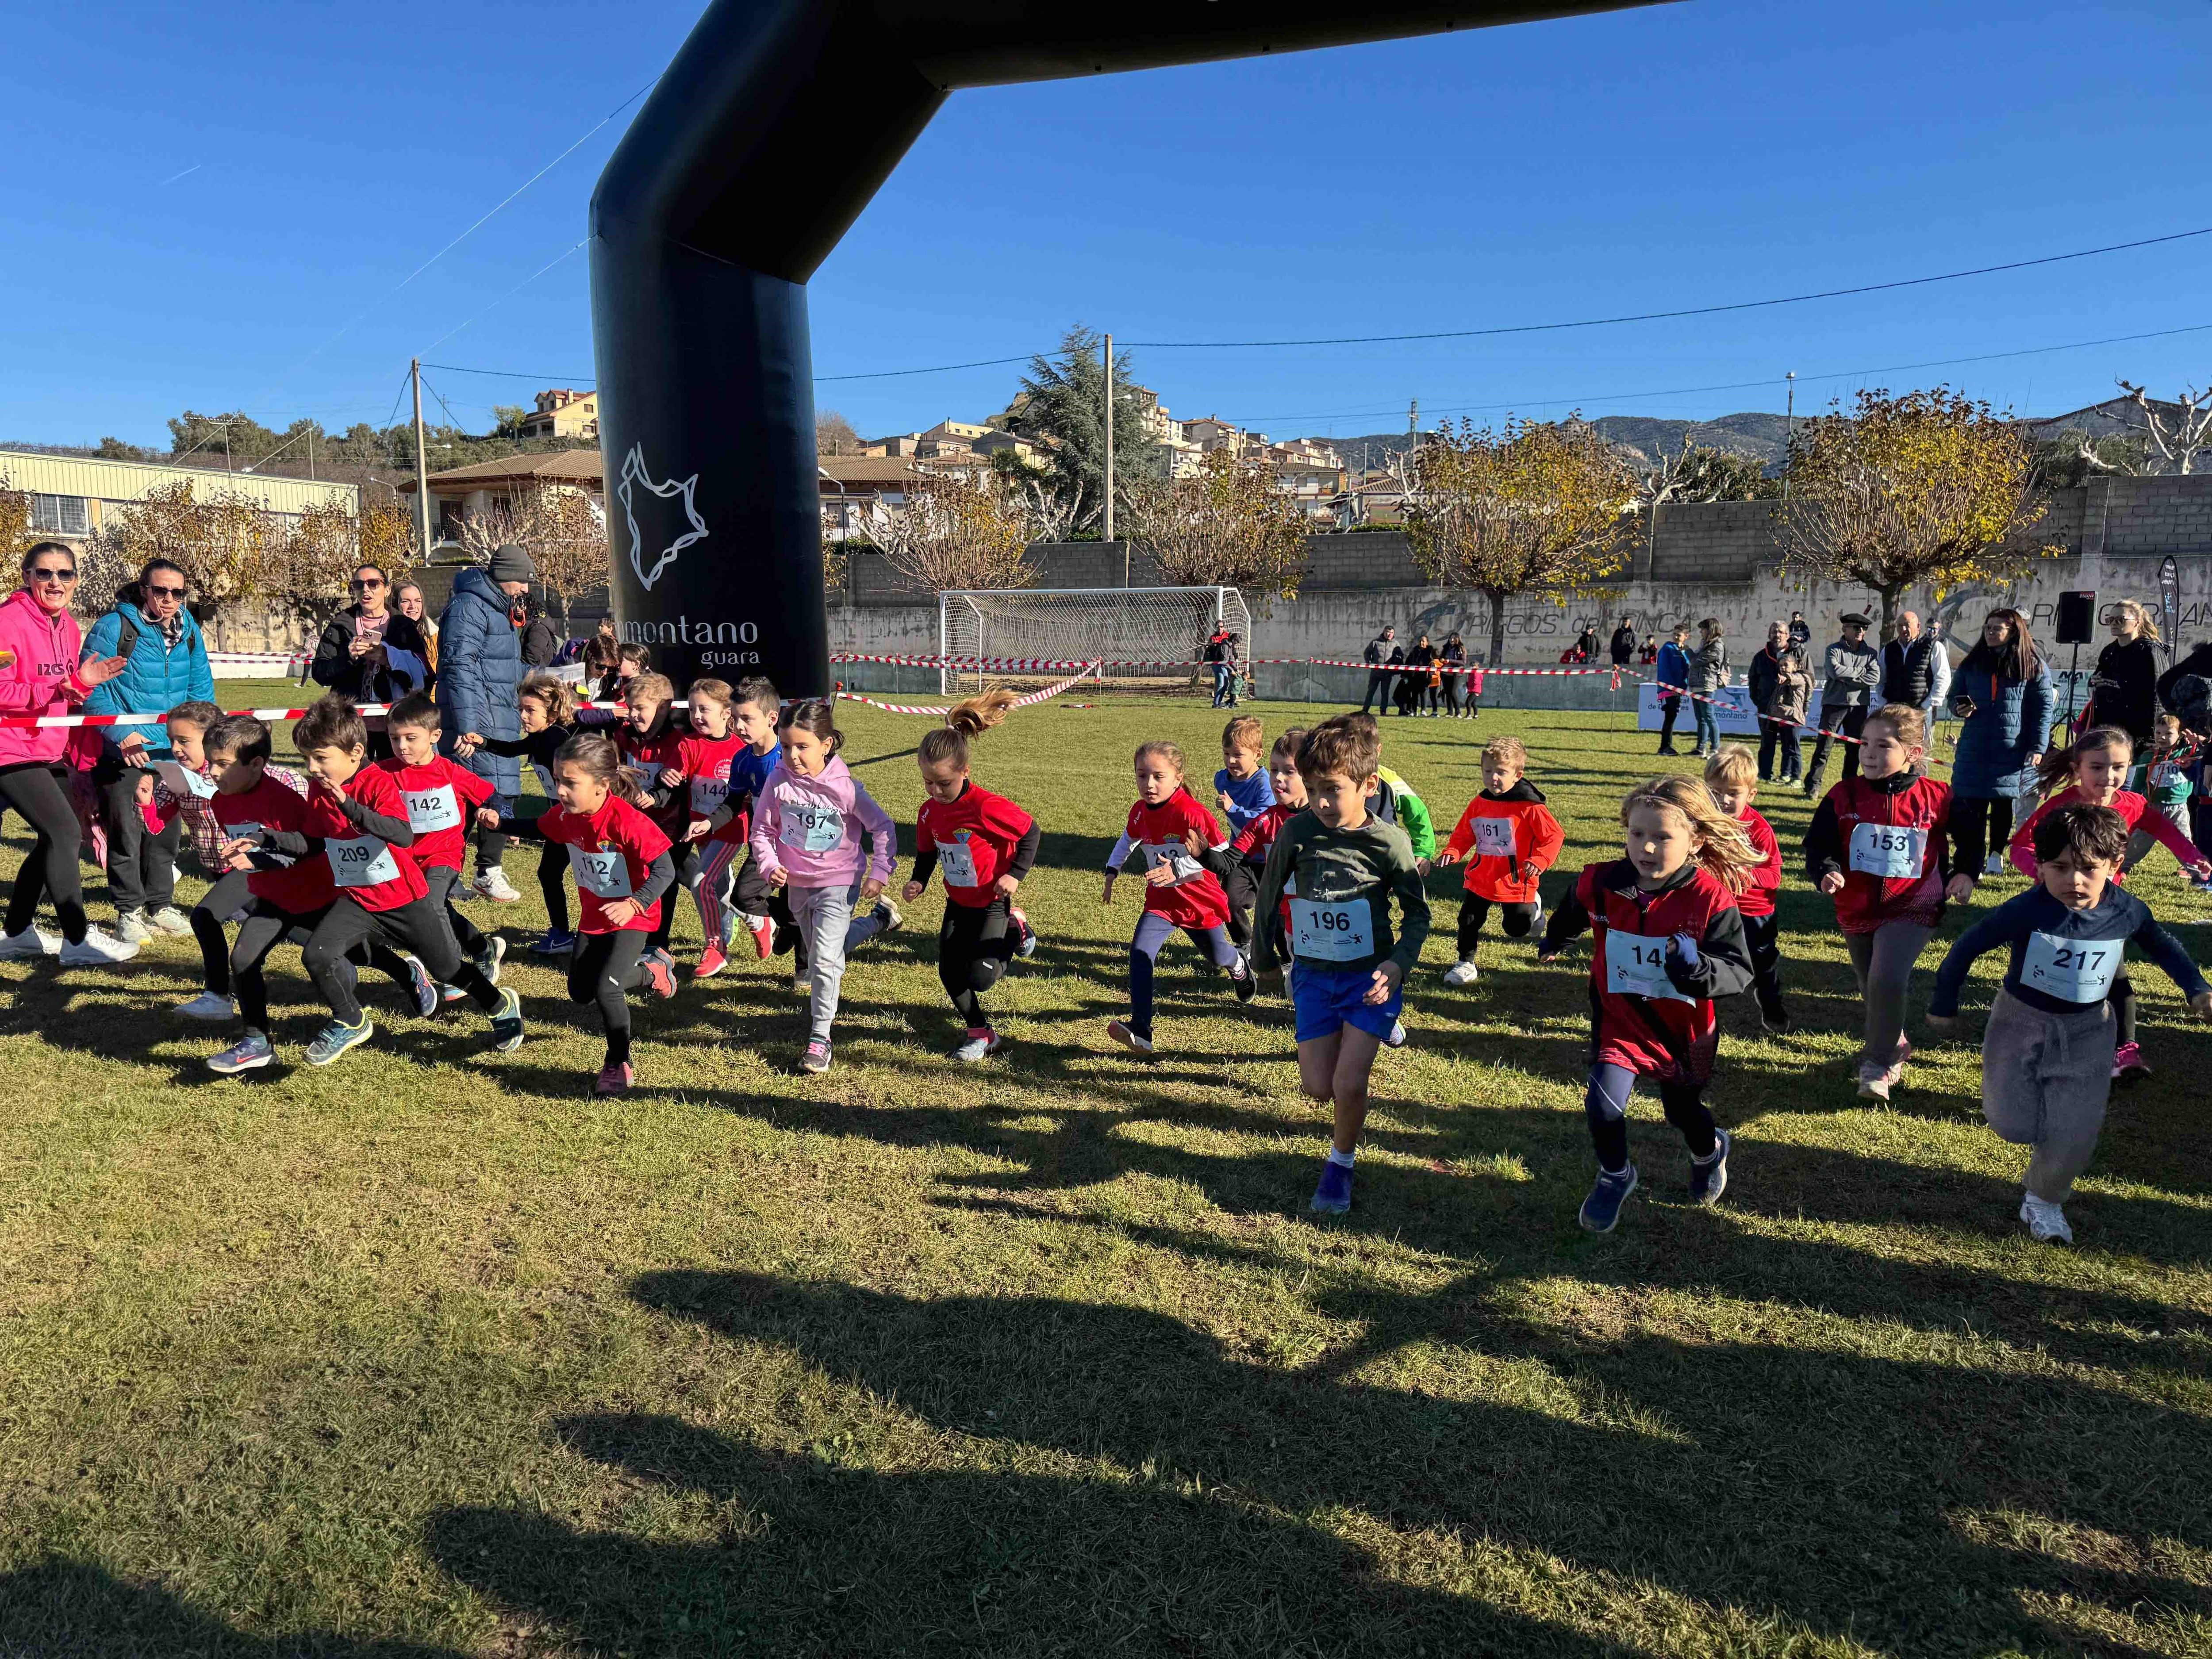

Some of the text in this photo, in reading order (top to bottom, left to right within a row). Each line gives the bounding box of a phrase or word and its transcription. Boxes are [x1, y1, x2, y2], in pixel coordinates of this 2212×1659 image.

[701, 651, 760, 669] guara
[702, 783, 728, 797] 144
[409, 797, 442, 811] 142
[797, 813, 828, 830] 197
[1482, 824, 1499, 837] 161
[1870, 833, 1907, 852] 153
[338, 845, 370, 862] 209
[937, 848, 955, 864] 11
[581, 856, 609, 875] 112
[1310, 910, 1350, 932] 196
[1631, 945, 1666, 968] 14
[2053, 948, 2106, 971] 217
